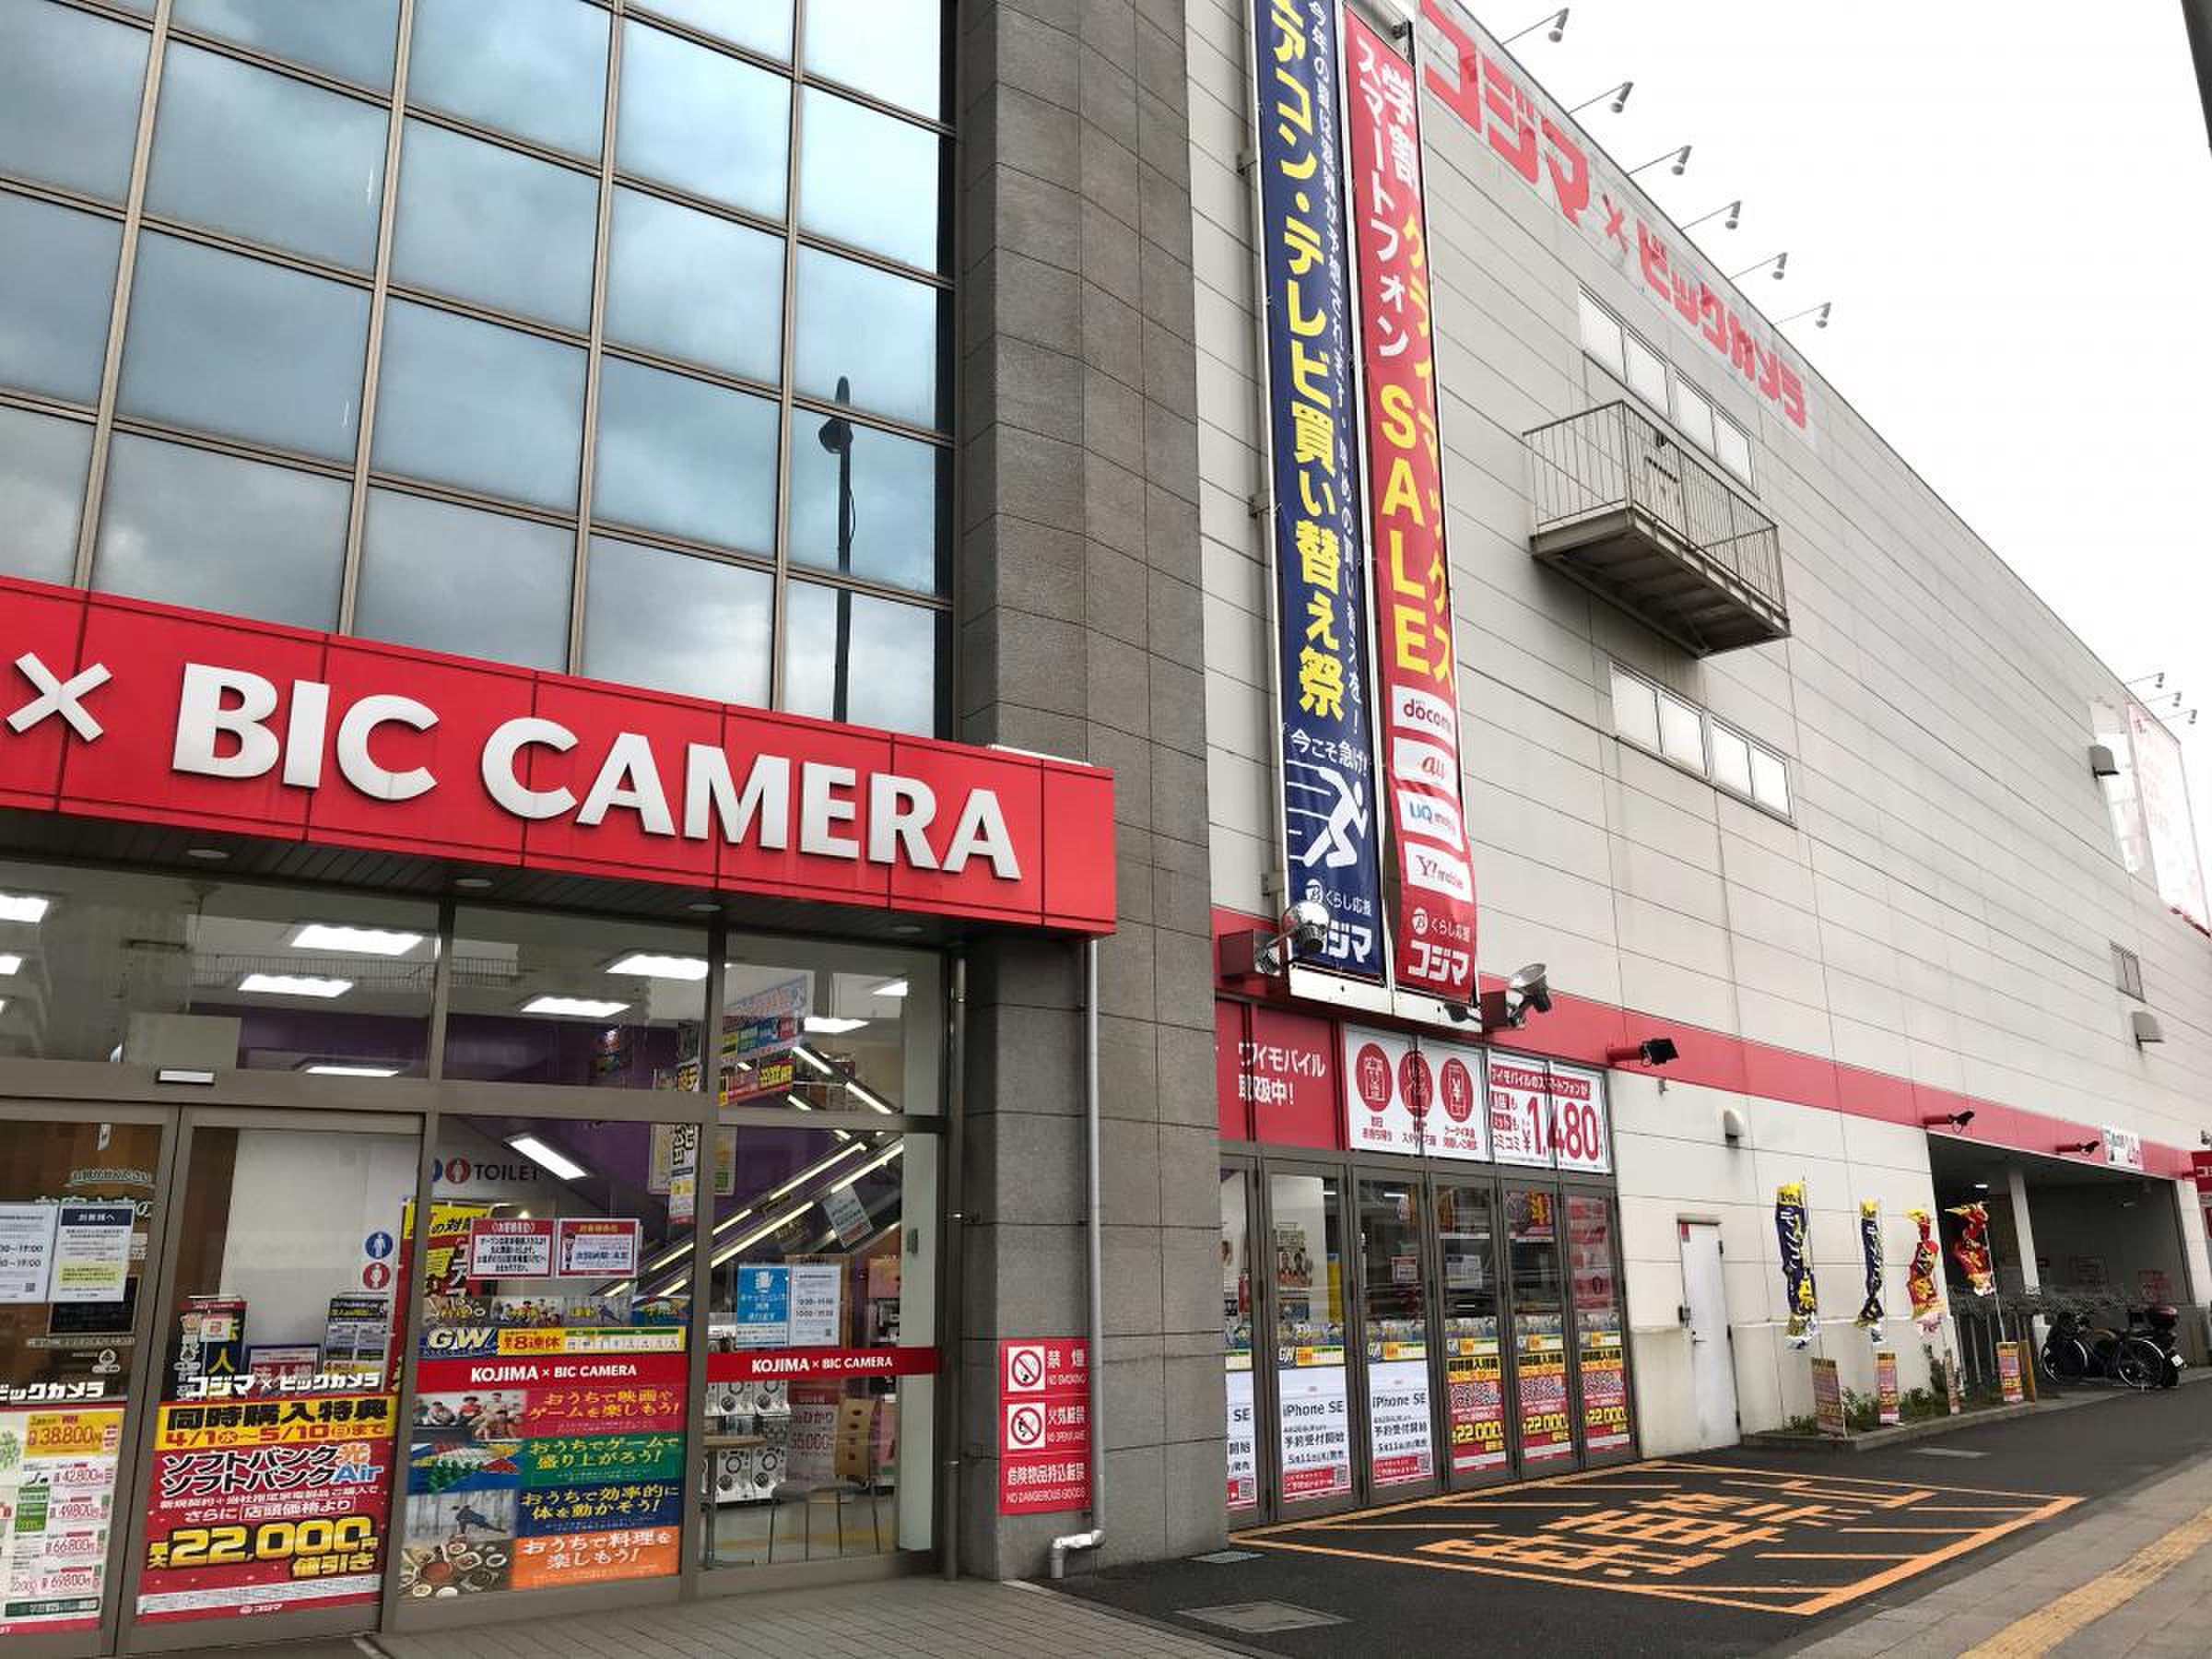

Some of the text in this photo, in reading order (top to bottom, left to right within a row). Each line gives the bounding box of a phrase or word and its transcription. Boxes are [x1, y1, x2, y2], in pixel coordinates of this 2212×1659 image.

[1419, 0, 1590, 228] コジマ
[1637, 217, 1806, 430] ビックカメラ
[1270, 0, 1345, 721] アコン・テレビ買い替え祭
[1357, 36, 1430, 676] スマートフォン SALE
[172, 663, 439, 801] BIC
[481, 717, 1022, 880] CAMERA
[1422, 756, 1446, 781] au
[1322, 920, 1372, 964] ジマ
[1407, 940, 1470, 986] コジマ
[1238, 1041, 1326, 1077] ワイモバイル
[473, 1164, 539, 1182] TOILET
[427, 1326, 496, 1349] GW
[471, 1365, 539, 1382] KOJIMA
[554, 1366, 577, 1378] BIC
[579, 1364, 637, 1378] CAMERA
[752, 1358, 810, 1373] KOJIMA
[821, 1357, 841, 1370] BIC
[843, 1355, 894, 1369] CAMERA
[186, 1376, 253, 1397] コジマ
[279, 1371, 381, 1391] ビックカメラ
[168, 1399, 388, 1430] 同時購入特典
[1233, 1408, 1252, 1422] SE
[1282, 1400, 1345, 1418] iPhone SE
[1372, 1393, 1427, 1409] iPhone SE
[163, 1442, 371, 1475] ソフトバンク光
[161, 1463, 384, 1498] ソフトバンクAir
